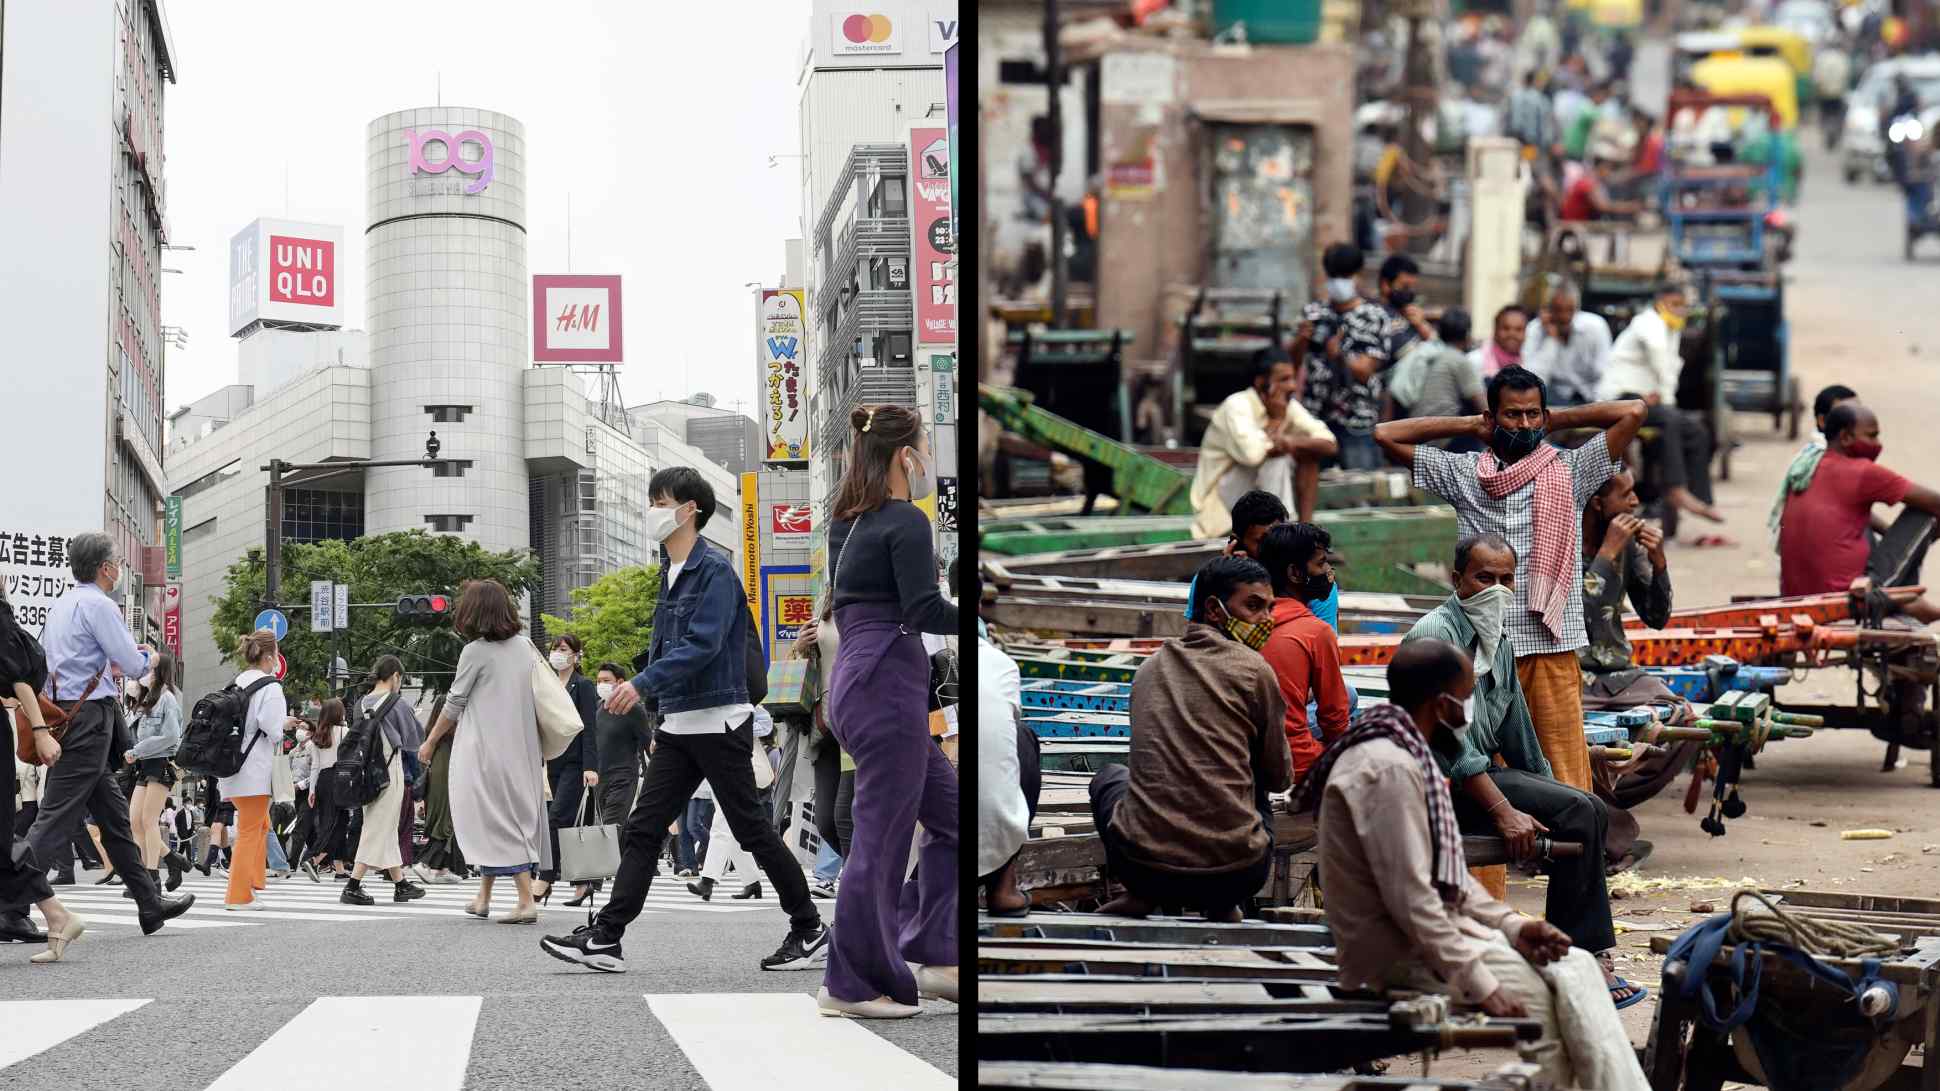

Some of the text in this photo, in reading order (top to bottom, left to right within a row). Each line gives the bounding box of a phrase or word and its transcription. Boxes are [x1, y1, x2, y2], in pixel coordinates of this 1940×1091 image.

[934, 20, 958, 40] V
[403, 129, 494, 193] 109
[277, 244, 323, 271] UNI
[277, 271, 327, 299] QLO
[556, 303, 600, 332] H&M
[167, 615, 177, 645] アコム
